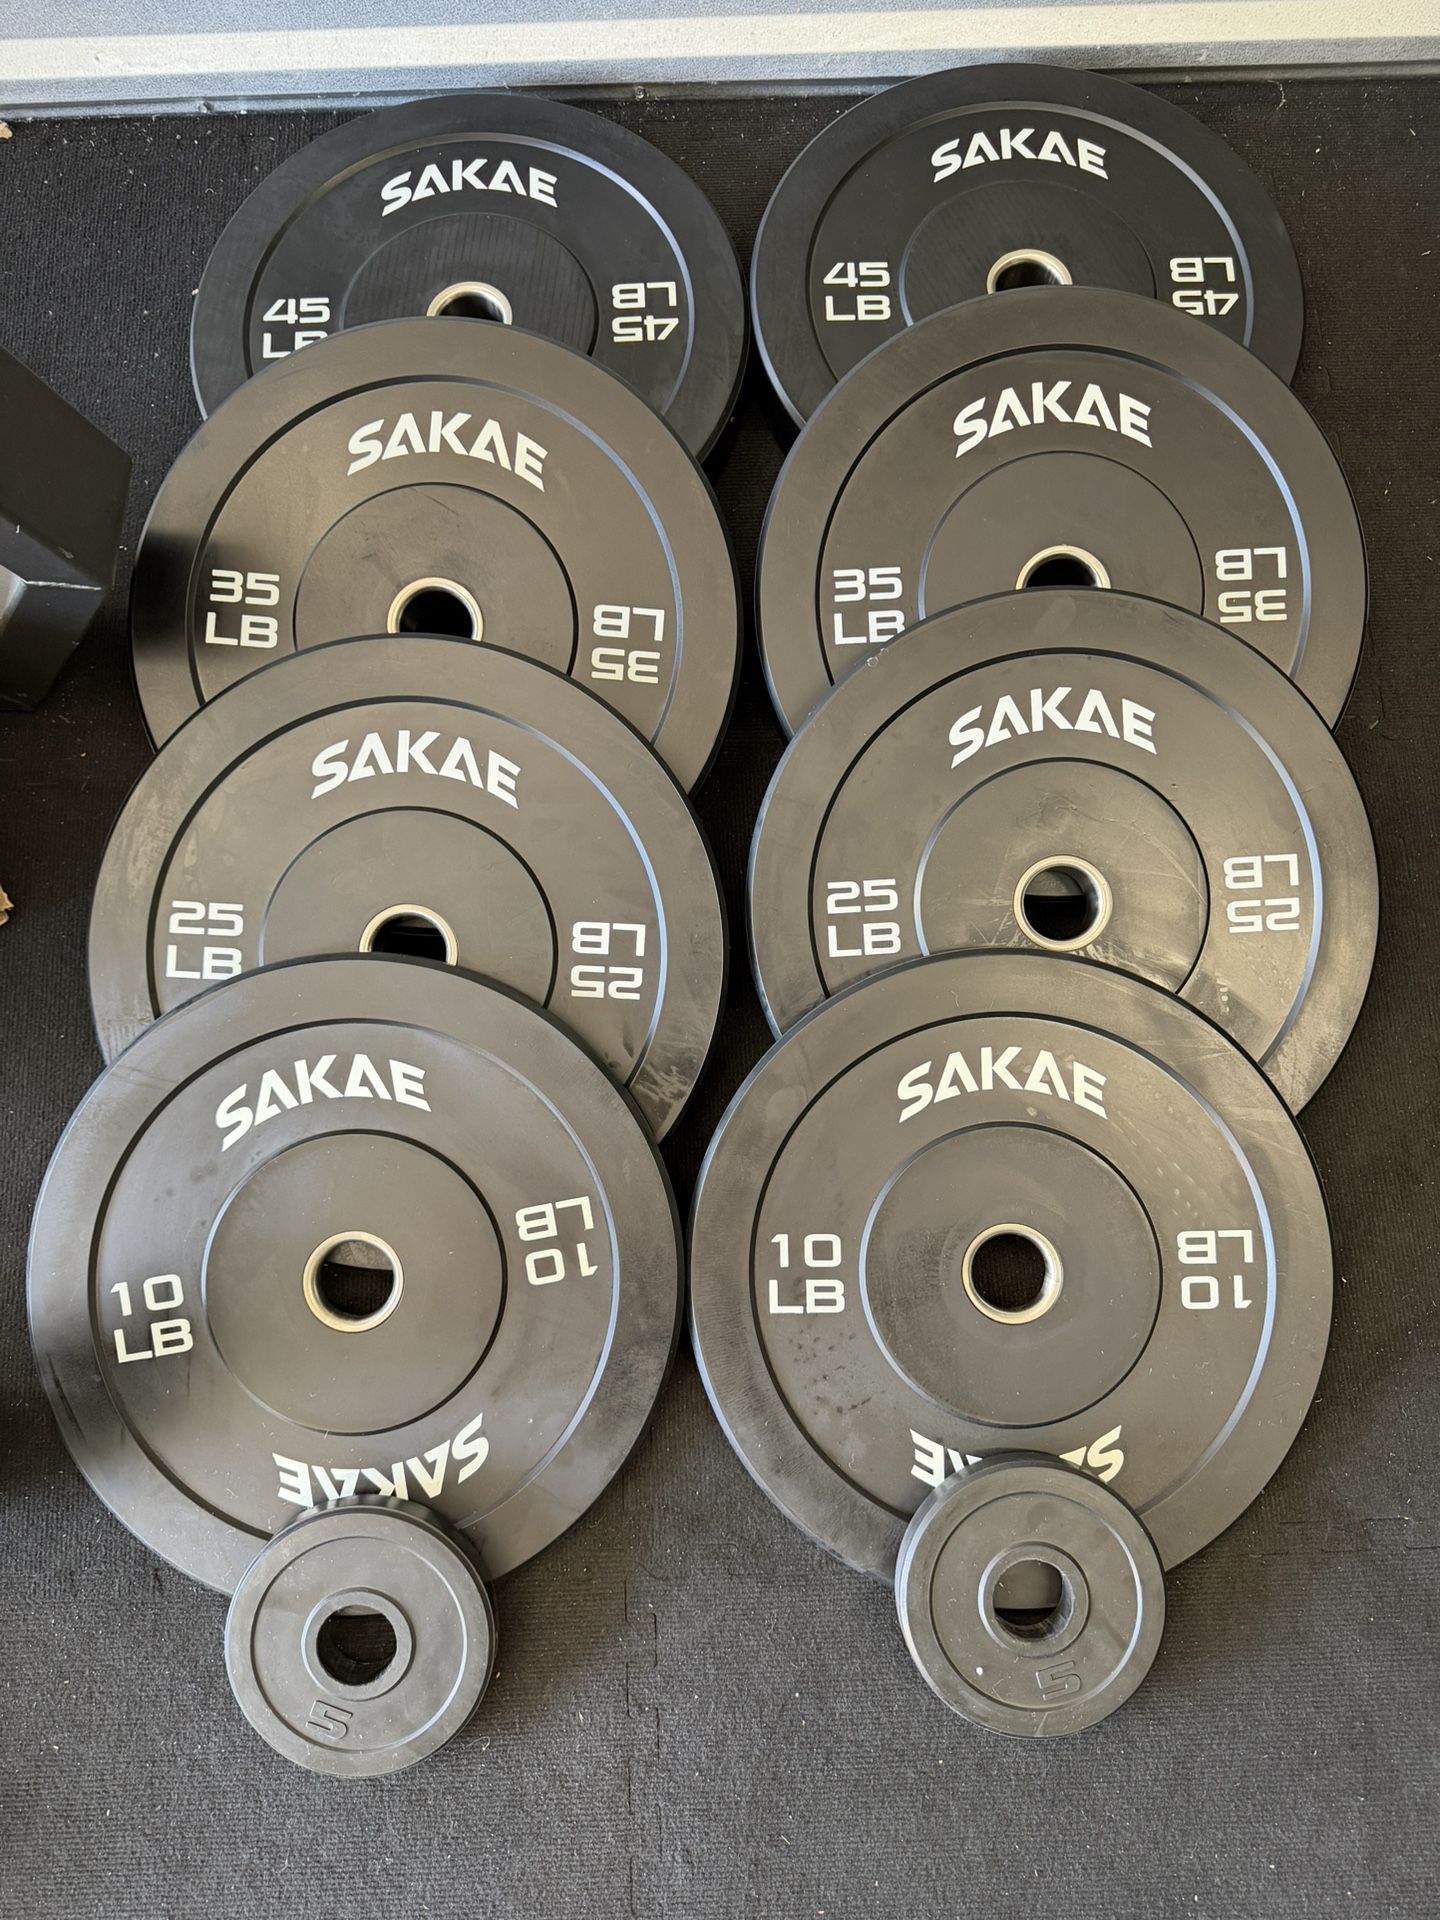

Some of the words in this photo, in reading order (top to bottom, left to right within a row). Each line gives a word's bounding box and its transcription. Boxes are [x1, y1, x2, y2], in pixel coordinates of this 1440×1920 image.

[932, 129, 1108, 182] SAKAE
[381, 159, 557, 216] SAKAE
[824, 262, 890, 287] 45
[1170, 257, 1235, 282] LB
[263, 298, 330, 324] 45
[612, 282, 677, 308] LB
[826, 295, 890, 321] LB
[1173, 290, 1239, 315] 45
[611, 315, 679, 342] 45
[954, 381, 1152, 458] SAKAE
[348, 411, 547, 491] SAKAE
[1216, 546, 1288, 580] LB
[210, 569, 279, 606] 35
[834, 567, 902, 602] 35
[594, 605, 665, 642] LB
[1219, 590, 1287, 622] 35
[205, 612, 278, 648] LB
[834, 610, 906, 645] LB
[591, 648, 660, 684] 35
[949, 687, 1156, 768] SAKAE
[312, 730, 520, 808] SAKAE
[1224, 854, 1299, 888] LB
[827, 879, 898, 914] 25
[170, 901, 244, 936] 25
[1227, 898, 1299, 932] 25
[572, 922, 646, 956] LB
[828, 922, 901, 957] LB
[166, 945, 242, 980] LB
[571, 965, 643, 1000] 25
[898, 1047, 1107, 1122] SAKAE
[216, 1054, 431, 1151] SAKAE
[515, 1196, 594, 1240] LB
[772, 1233, 841, 1267] 10
[1177, 1229, 1254, 1264] LB
[525, 1243, 598, 1286] 10
[111, 1274, 184, 1317] 10
[769, 1280, 845, 1314] LB
[1181, 1275, 1252, 1310] 10
[114, 1318, 194, 1364] LB
[1035, 1660, 1082, 1701] 5
[305, 1700, 353, 1740] 5
